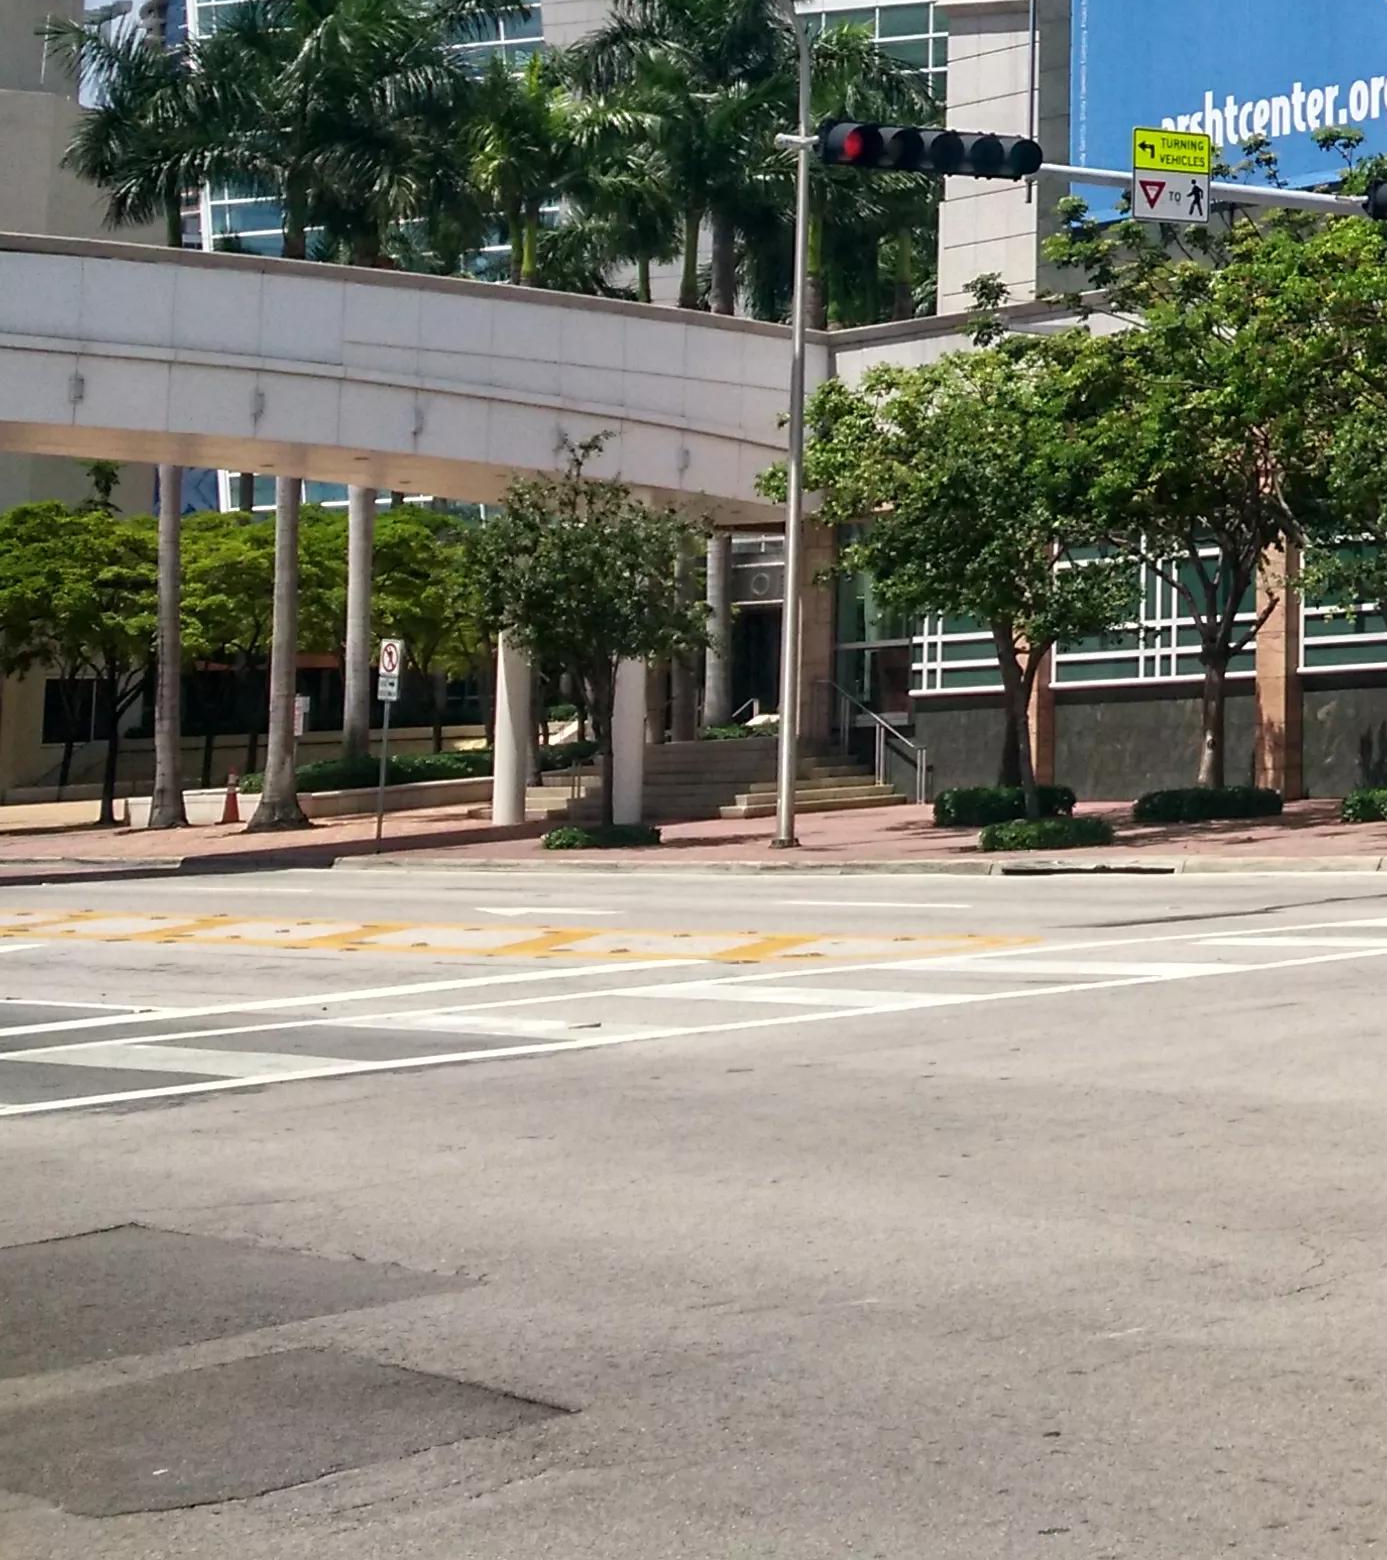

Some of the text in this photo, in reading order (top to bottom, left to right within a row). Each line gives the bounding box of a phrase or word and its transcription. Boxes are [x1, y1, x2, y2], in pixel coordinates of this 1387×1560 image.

[1161, 137, 1204, 151] TURNING
[1159, 154, 1205, 167] VEHICLES
[1169, 191, 1181, 202] TO
